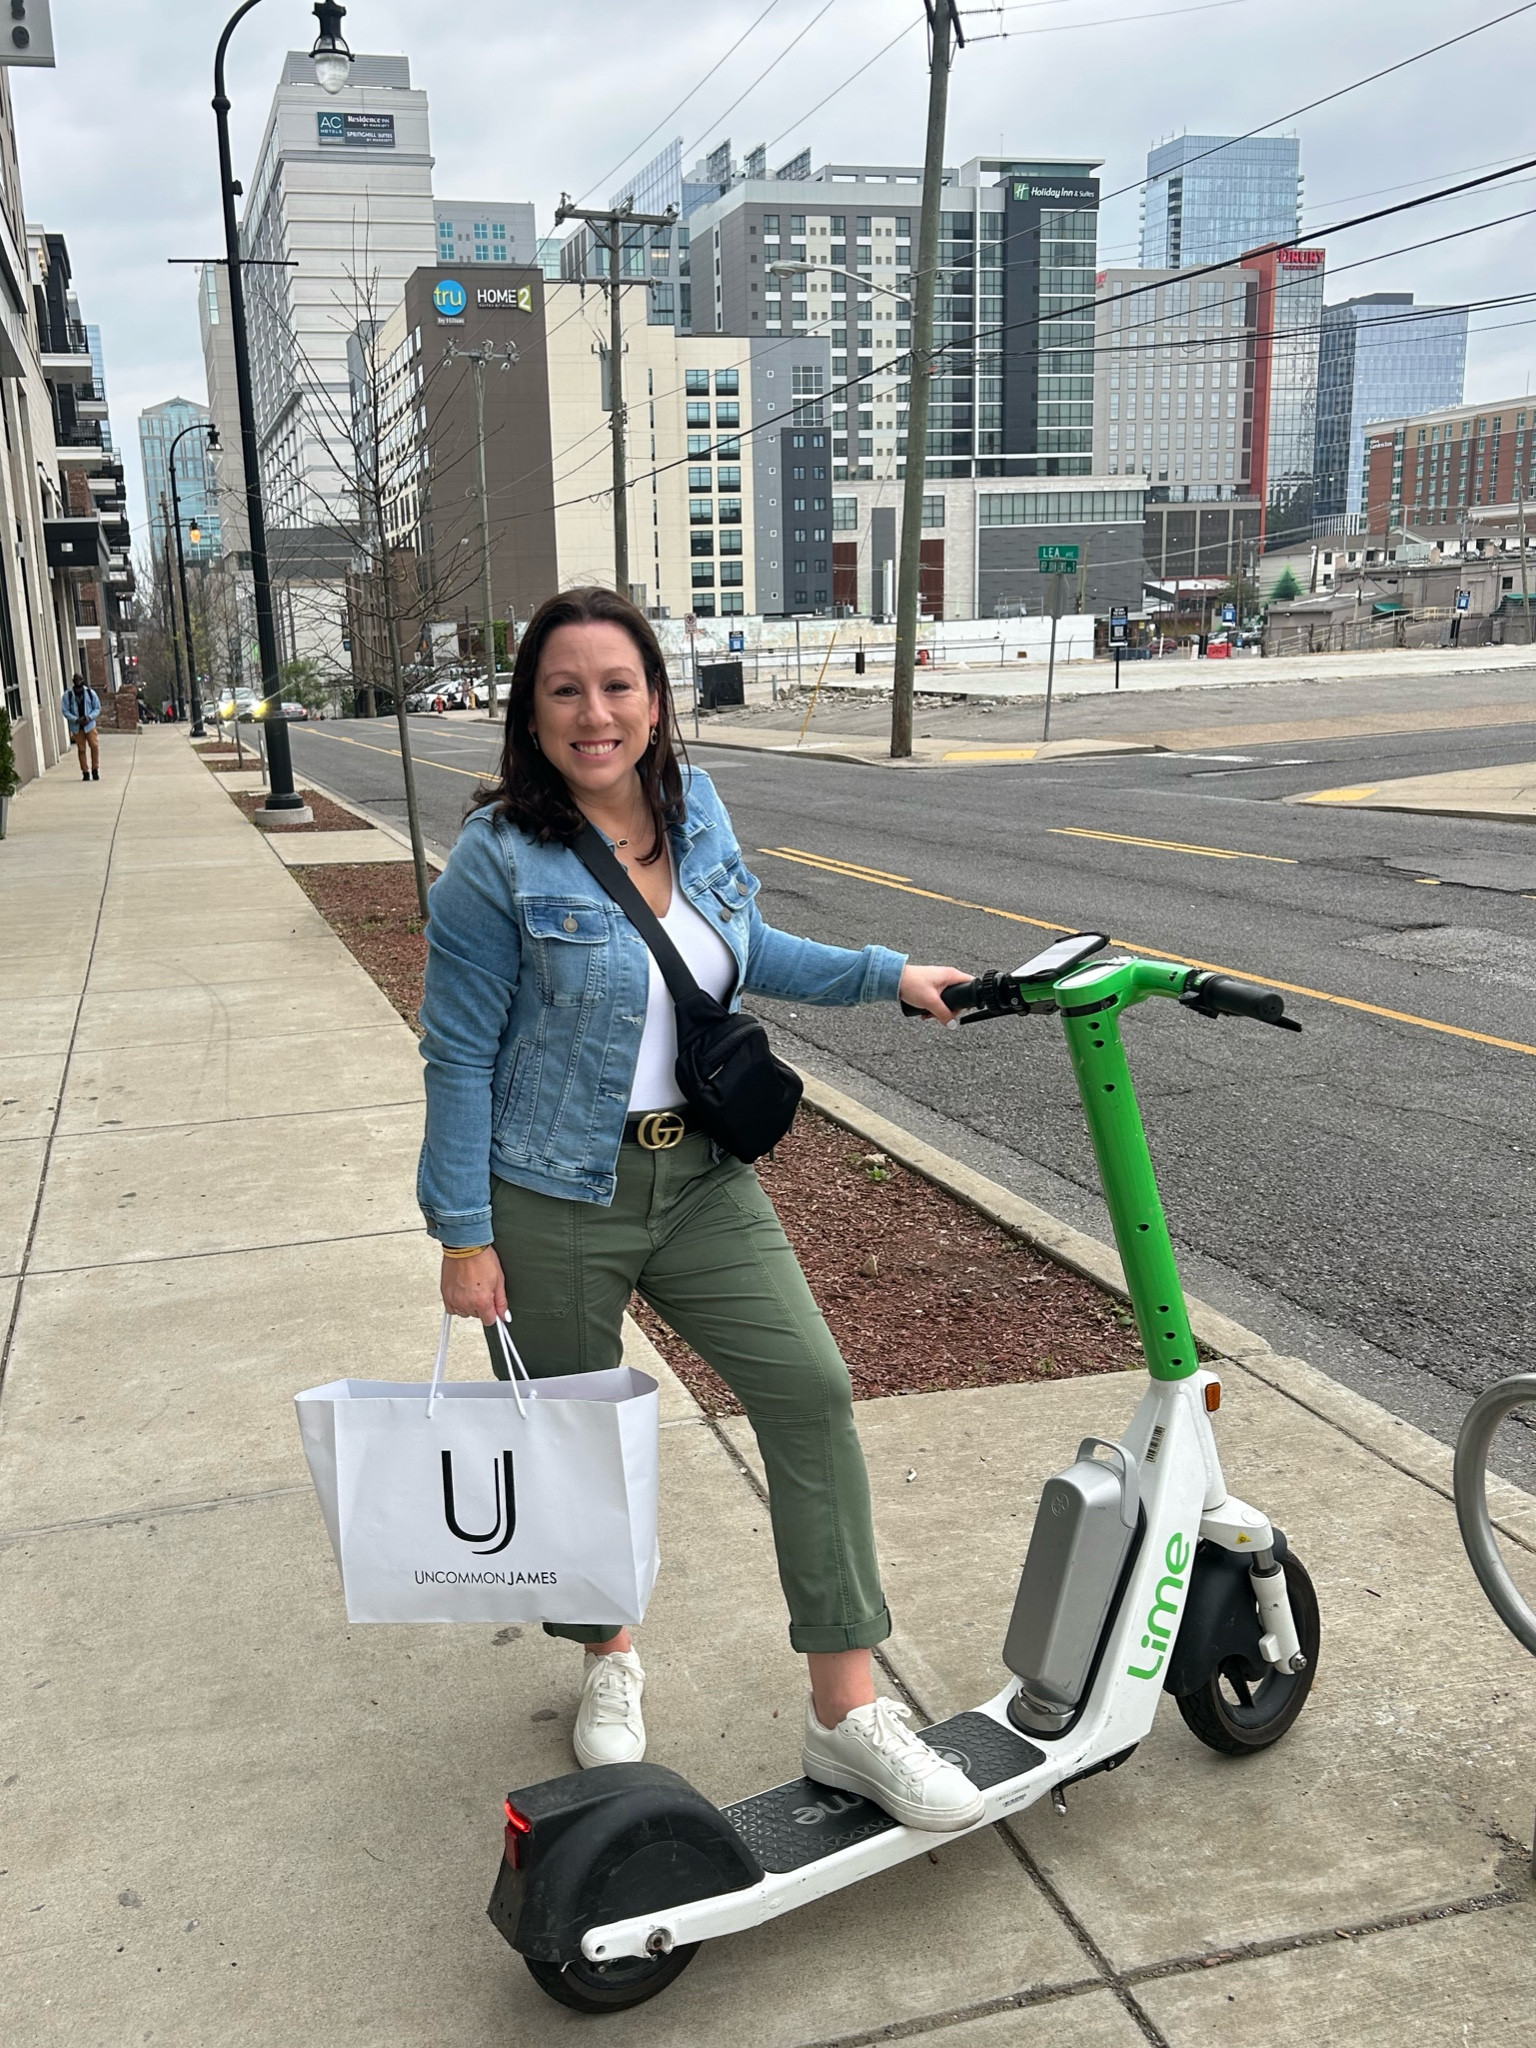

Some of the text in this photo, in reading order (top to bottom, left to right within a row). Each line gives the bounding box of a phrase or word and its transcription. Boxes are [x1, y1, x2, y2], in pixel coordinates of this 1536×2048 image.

[320, 116, 342, 129] AC
[347, 115, 381, 123] Residence
[1031, 186, 1061, 199] Holiday
[1060, 187, 1073, 197] Inn
[1280, 248, 1324, 263] DRURY
[433, 286, 462, 306] tru
[1042, 547, 1060, 558] LEA
[1126, 1532, 1190, 1680] Lime
[791, 1794, 864, 1826] me
